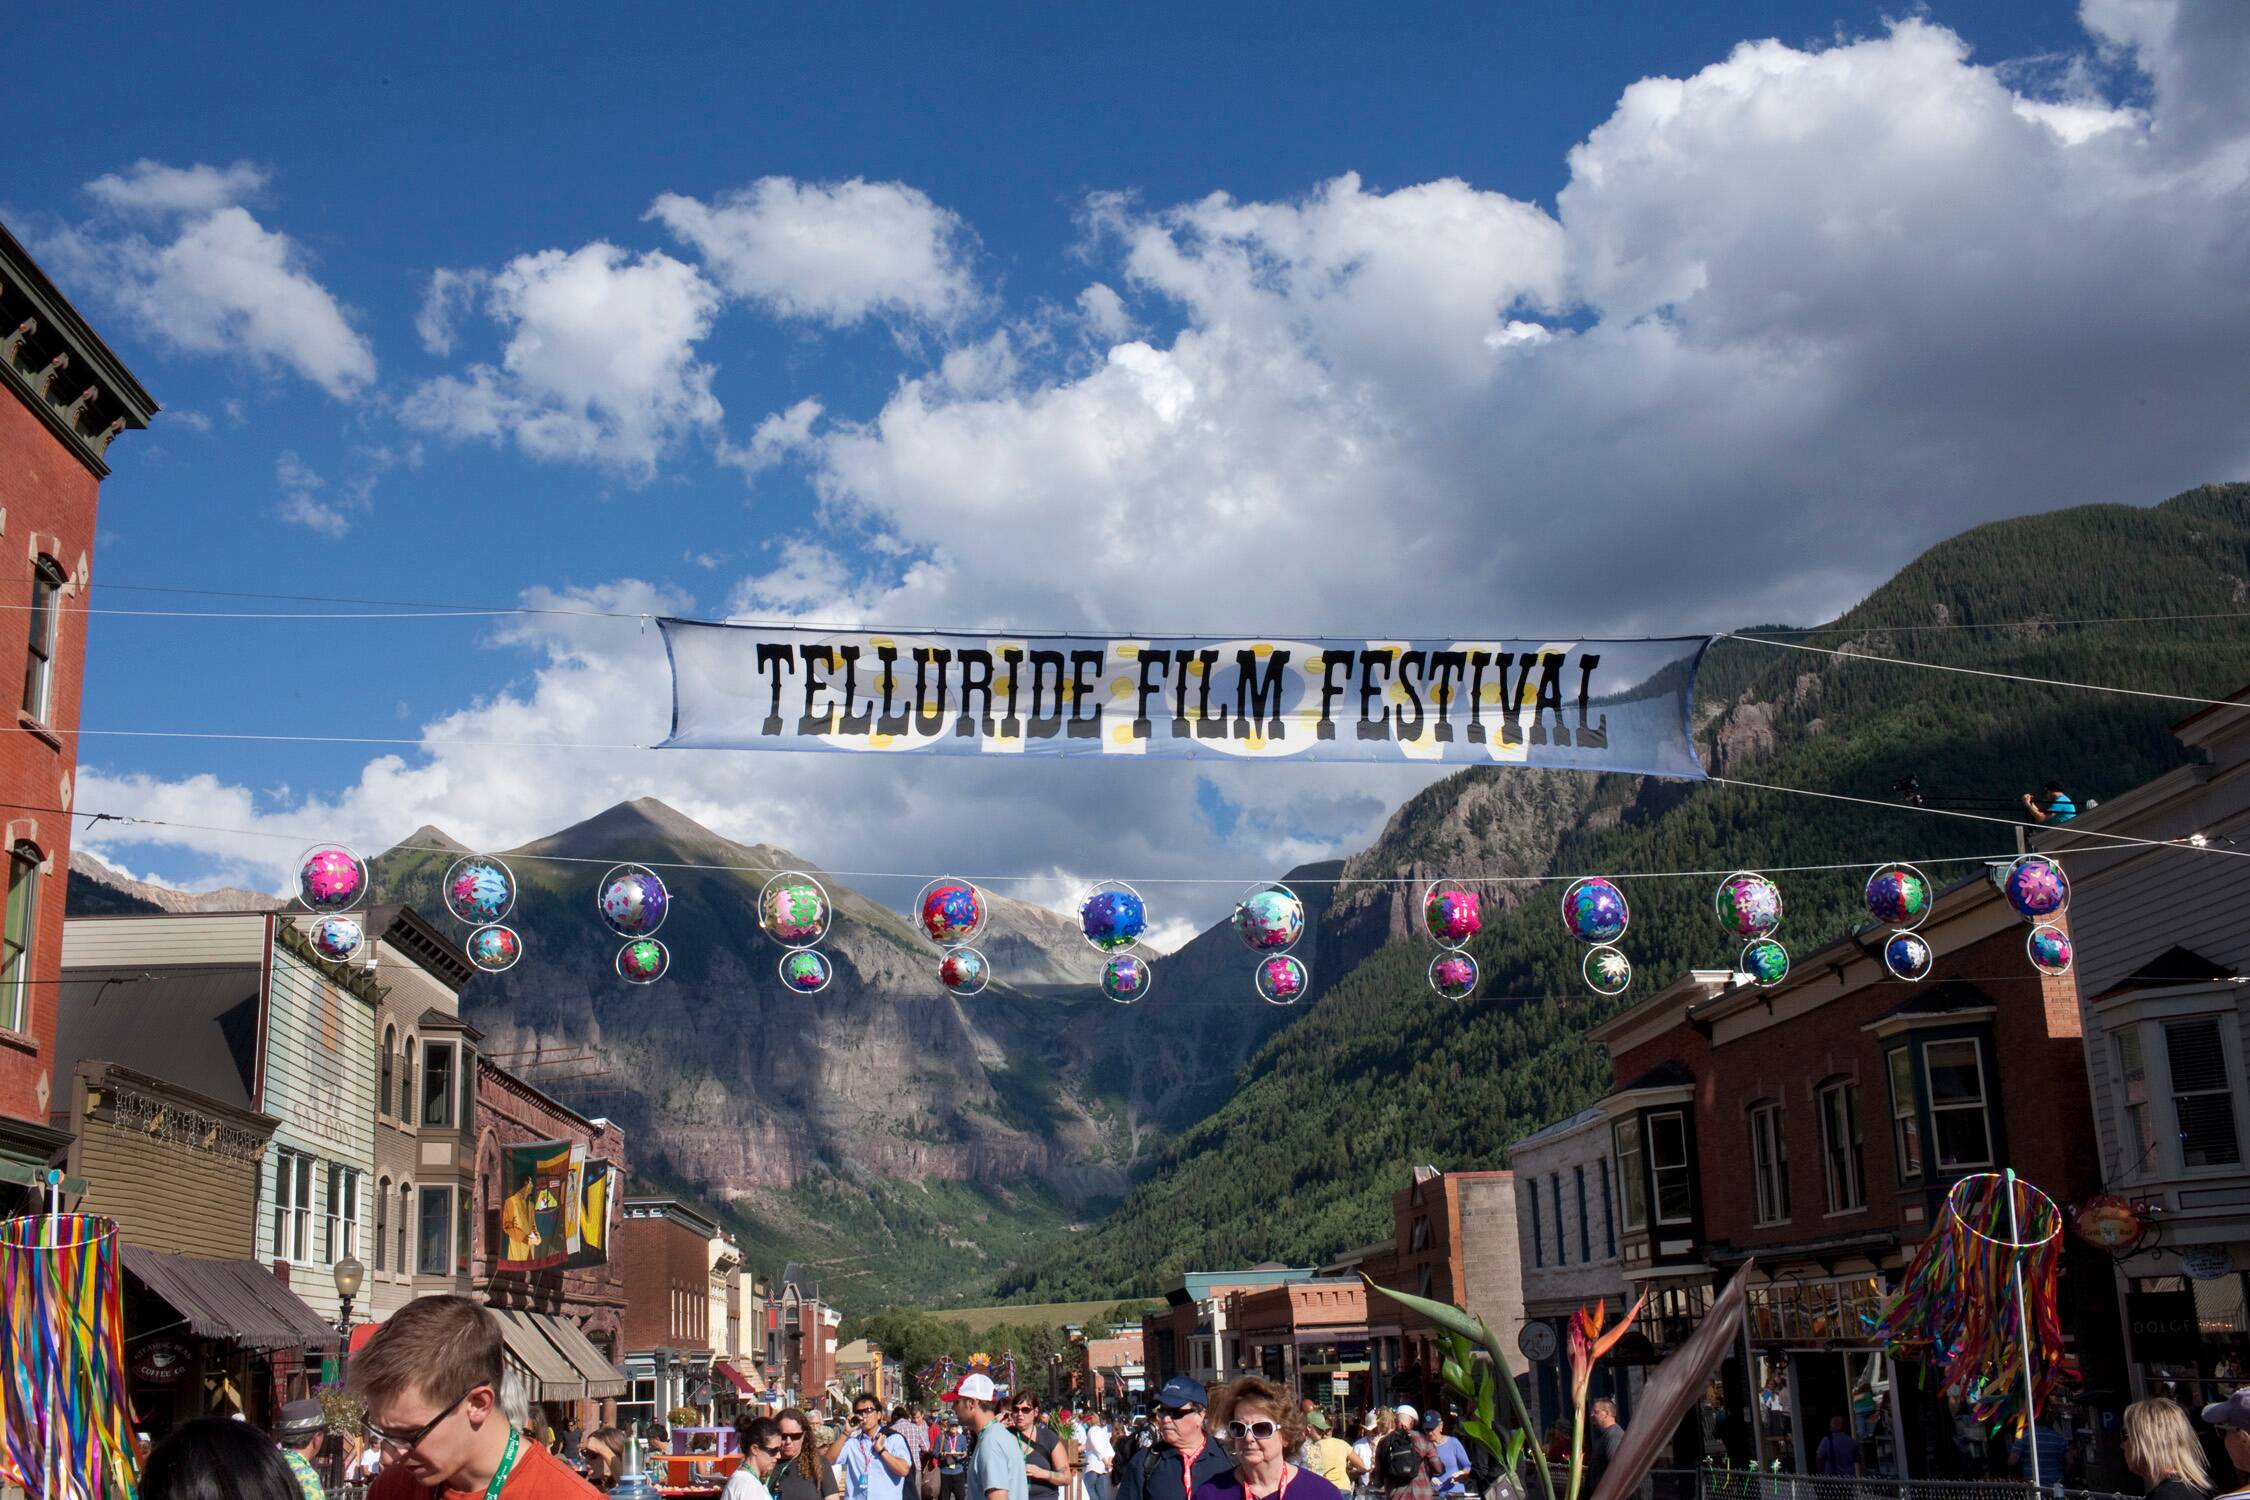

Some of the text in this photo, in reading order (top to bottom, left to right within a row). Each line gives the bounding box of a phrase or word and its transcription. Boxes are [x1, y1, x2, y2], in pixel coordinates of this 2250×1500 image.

[756, 642, 1607, 750] TELLURIDE FILM FESTIVAL
[292, 1102, 353, 1146] SALOON
[2133, 1319, 2192, 1335] DOLCE
[141, 1366, 171, 1377] COFFEE
[2102, 1411, 2113, 1429] P
